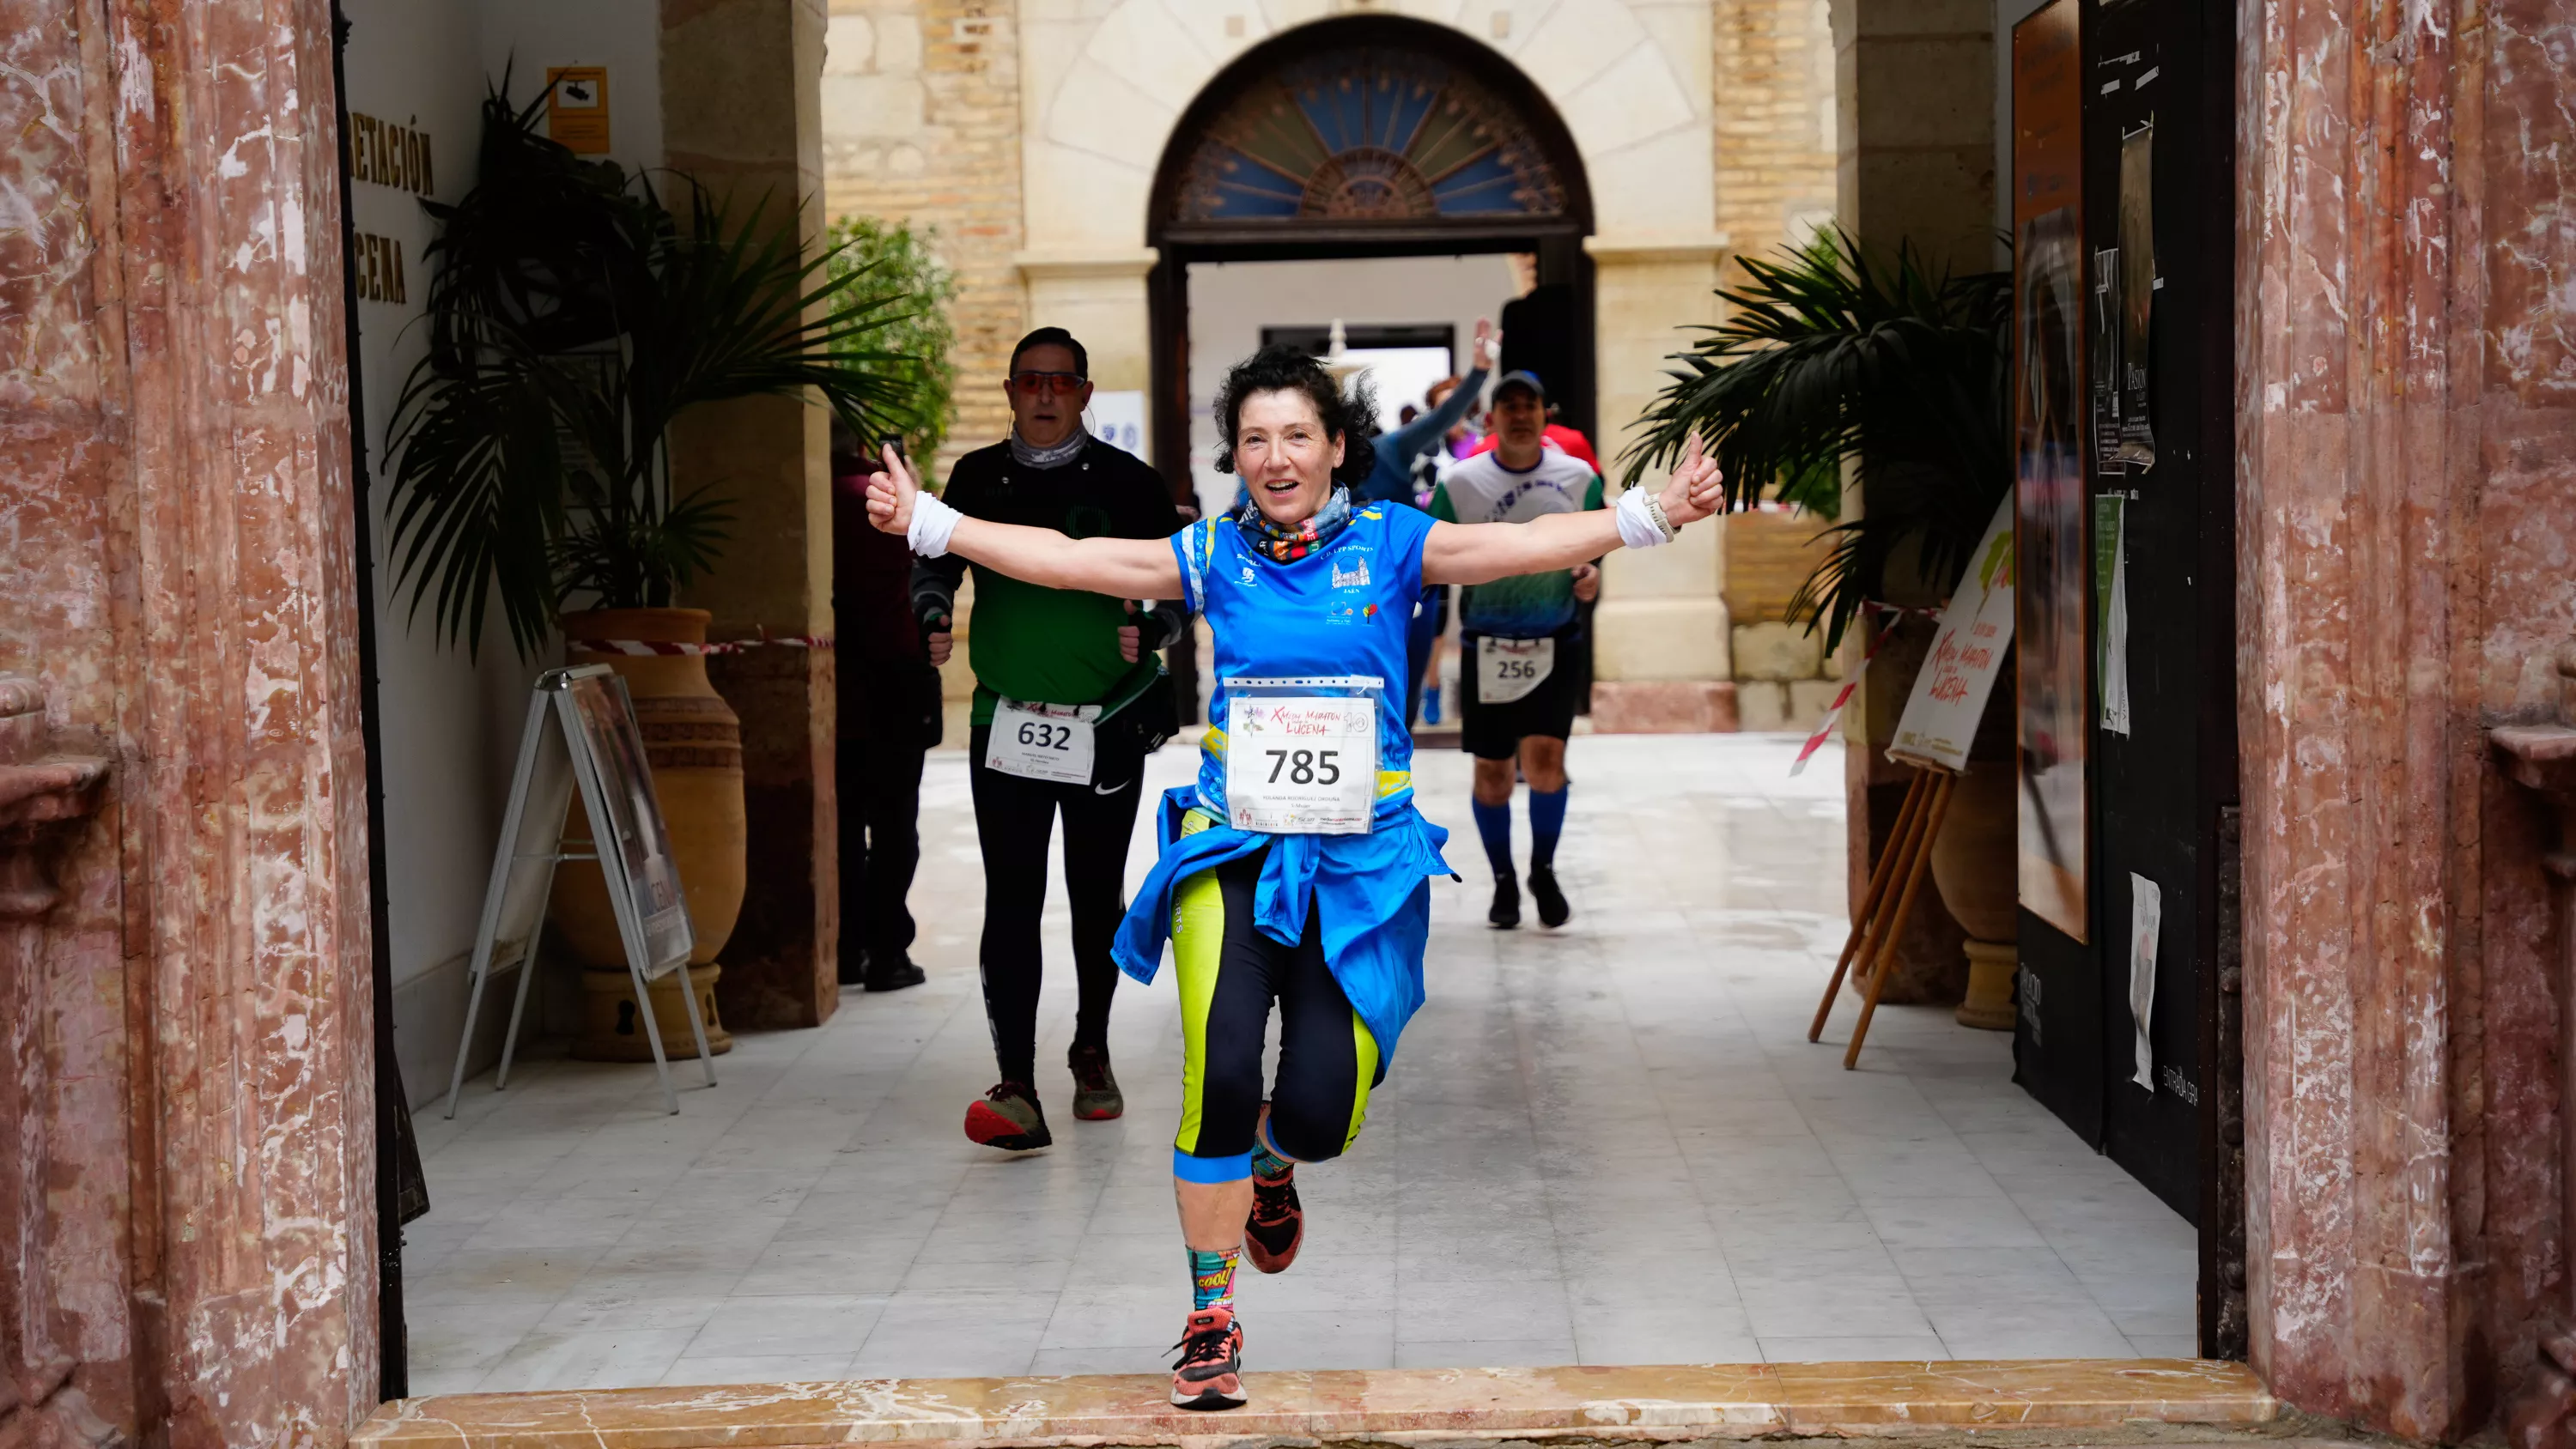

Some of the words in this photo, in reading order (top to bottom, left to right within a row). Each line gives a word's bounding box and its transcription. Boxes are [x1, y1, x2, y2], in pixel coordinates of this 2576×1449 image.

[1498, 660, 1535, 679] 256
[1018, 722, 1071, 751] 632
[1286, 722, 1331, 737] LUCENA
[1266, 749, 1340, 785] 785
